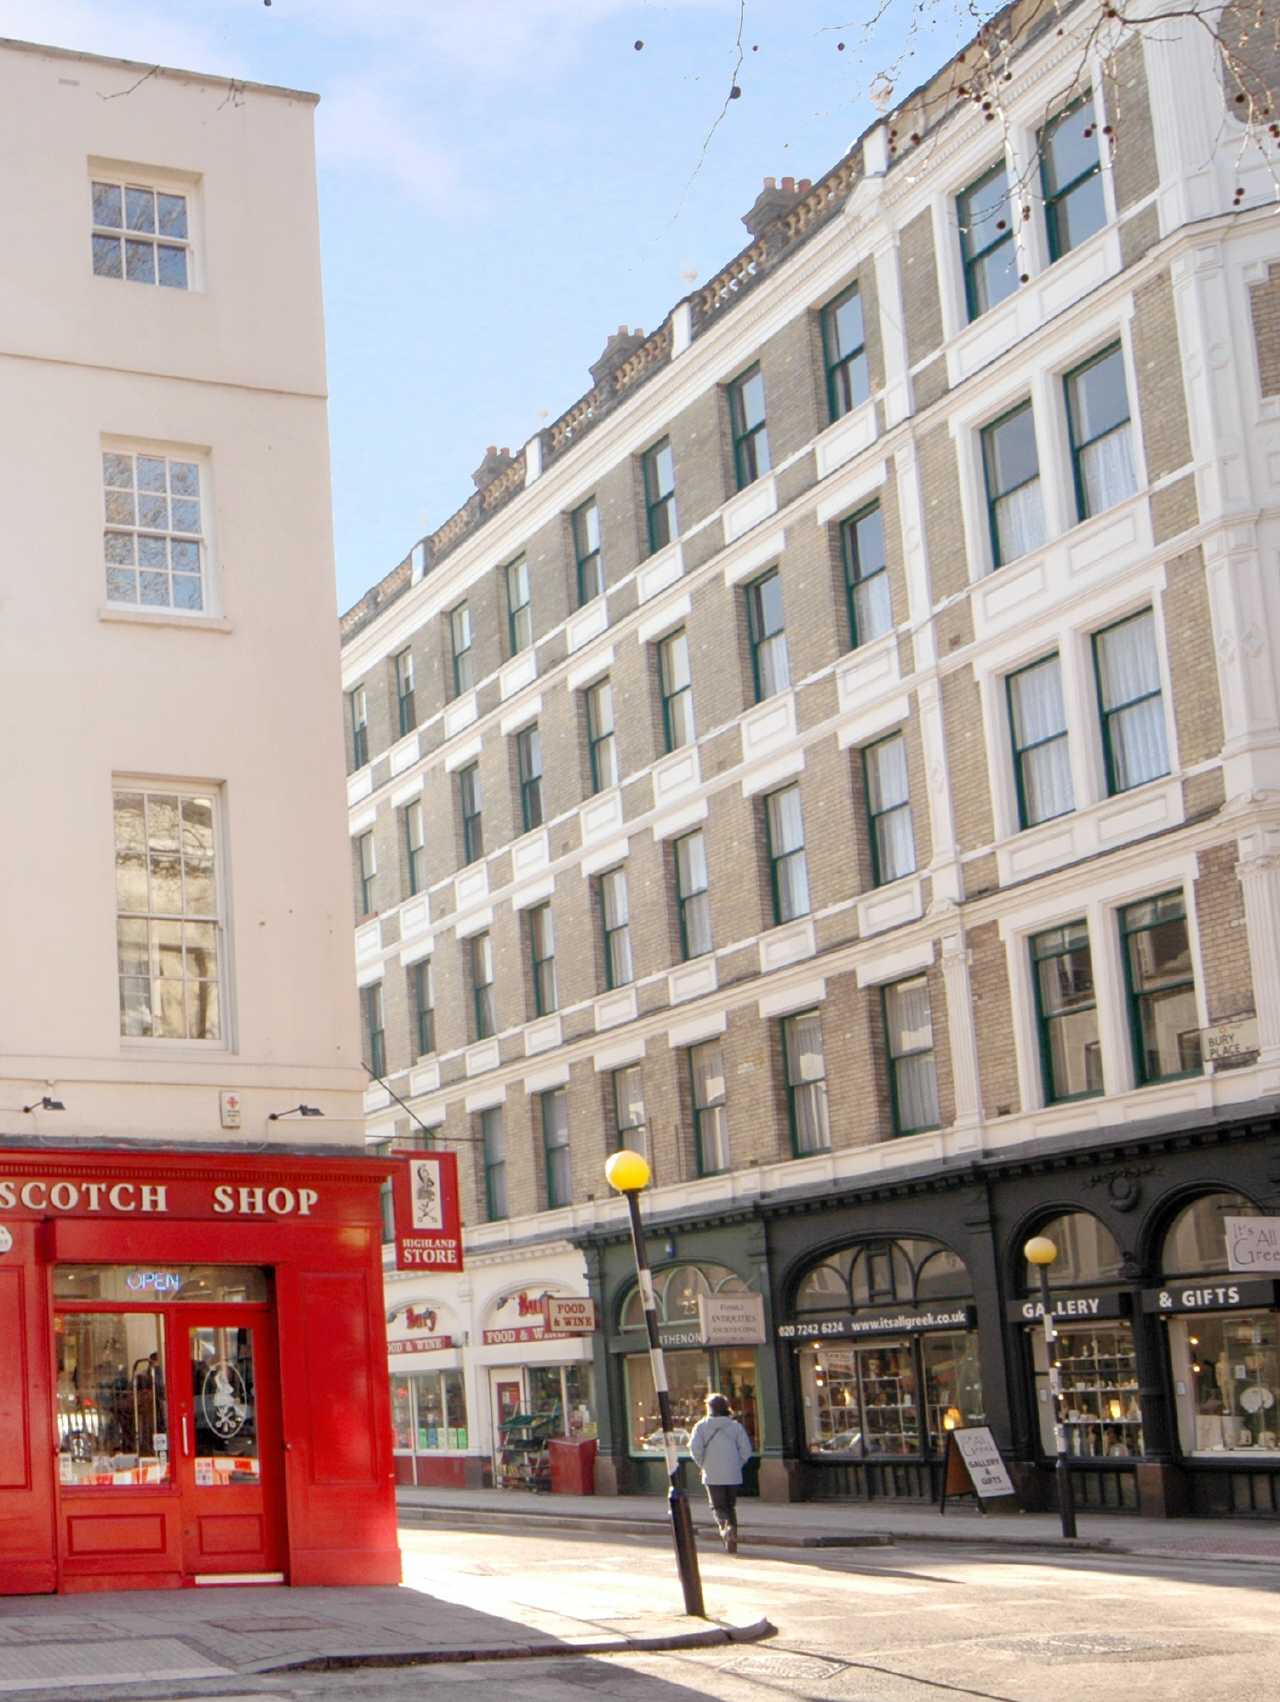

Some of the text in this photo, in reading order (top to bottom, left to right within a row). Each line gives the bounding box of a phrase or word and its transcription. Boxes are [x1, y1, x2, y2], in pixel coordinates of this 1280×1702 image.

[1208, 1034, 1234, 1047] BURY
[1209, 1043, 1241, 1058] PLACE
[212, 1184, 319, 1216] SHOP
[402, 1238, 457, 1249] HIGHLAND
[403, 1247, 458, 1264] STORE
[1232, 1238, 1280, 1266] Gree
[127, 1271, 181, 1291] OPEN
[1158, 1286, 1241, 1308] & GIFTS
[557, 1303, 586, 1315] FOOD
[1022, 1298, 1099, 1318] GALERY
[563, 1315, 593, 1327] WINE
[797, 1323, 819, 1336] 7242
[821, 1321, 844, 1334] 6224
[487, 1330, 516, 1344] FOOD
[414, 1339, 441, 1352] WINE
